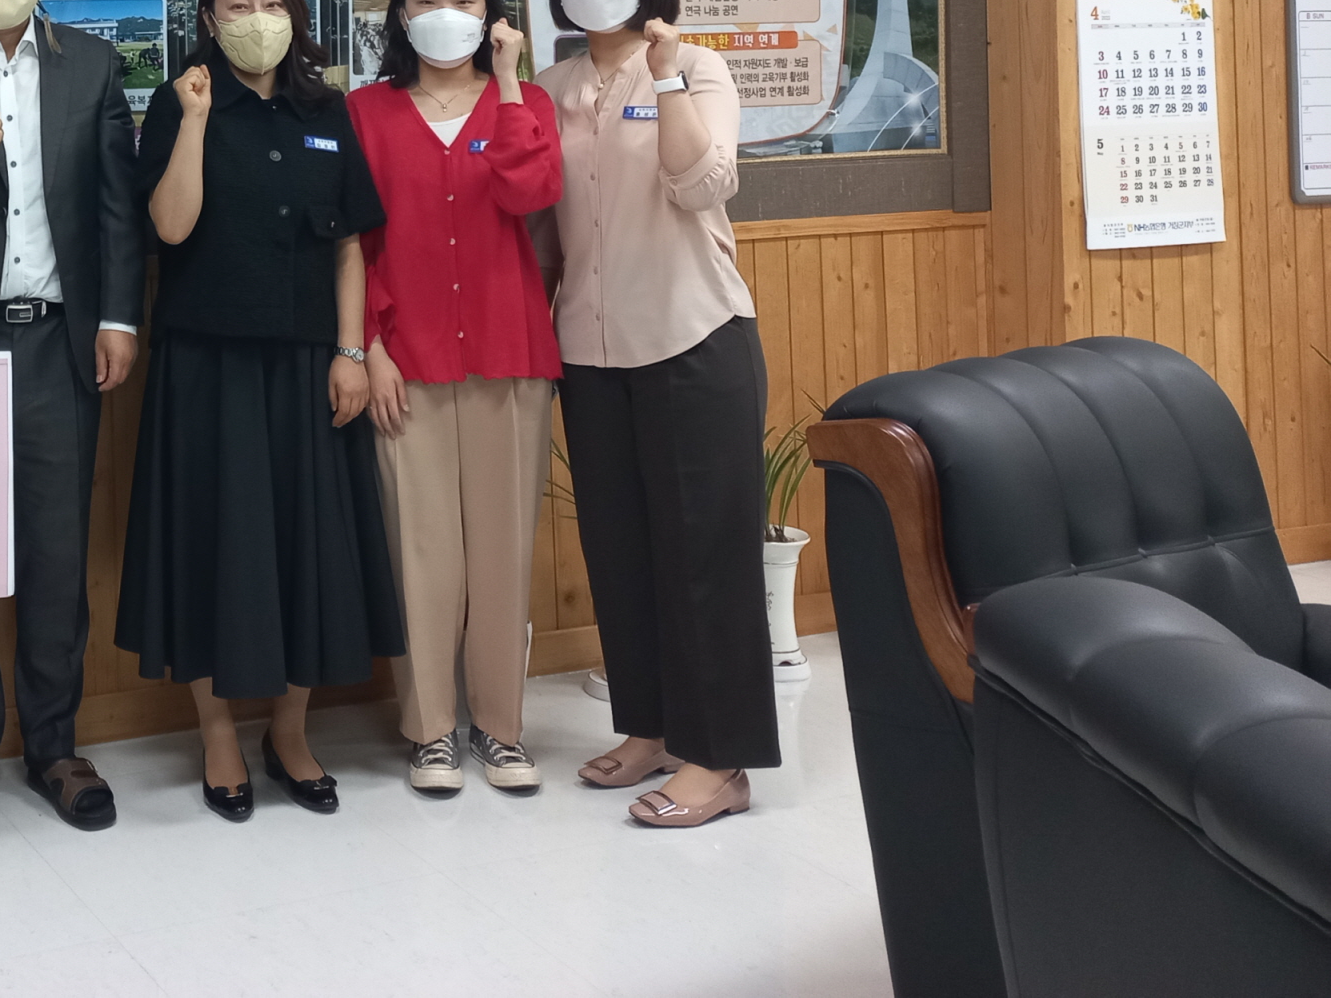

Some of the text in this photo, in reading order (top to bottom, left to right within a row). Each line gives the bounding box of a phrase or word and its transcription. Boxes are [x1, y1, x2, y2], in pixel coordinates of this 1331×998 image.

[1090, 6, 1099, 20] 4
[733, 34, 754, 47] 지역
[1181, 31, 1202, 41] 1 2
[1099, 49, 1203, 61] 3 4 5 6 7 8 9
[1098, 67, 1205, 79] 10 11 12 13 14 15 16
[1099, 85, 1207, 97] 17 18 19 20 21 22 23
[1099, 102, 1207, 115] 24 25 26 27 28 29 30
[1097, 138, 1104, 149] 5
